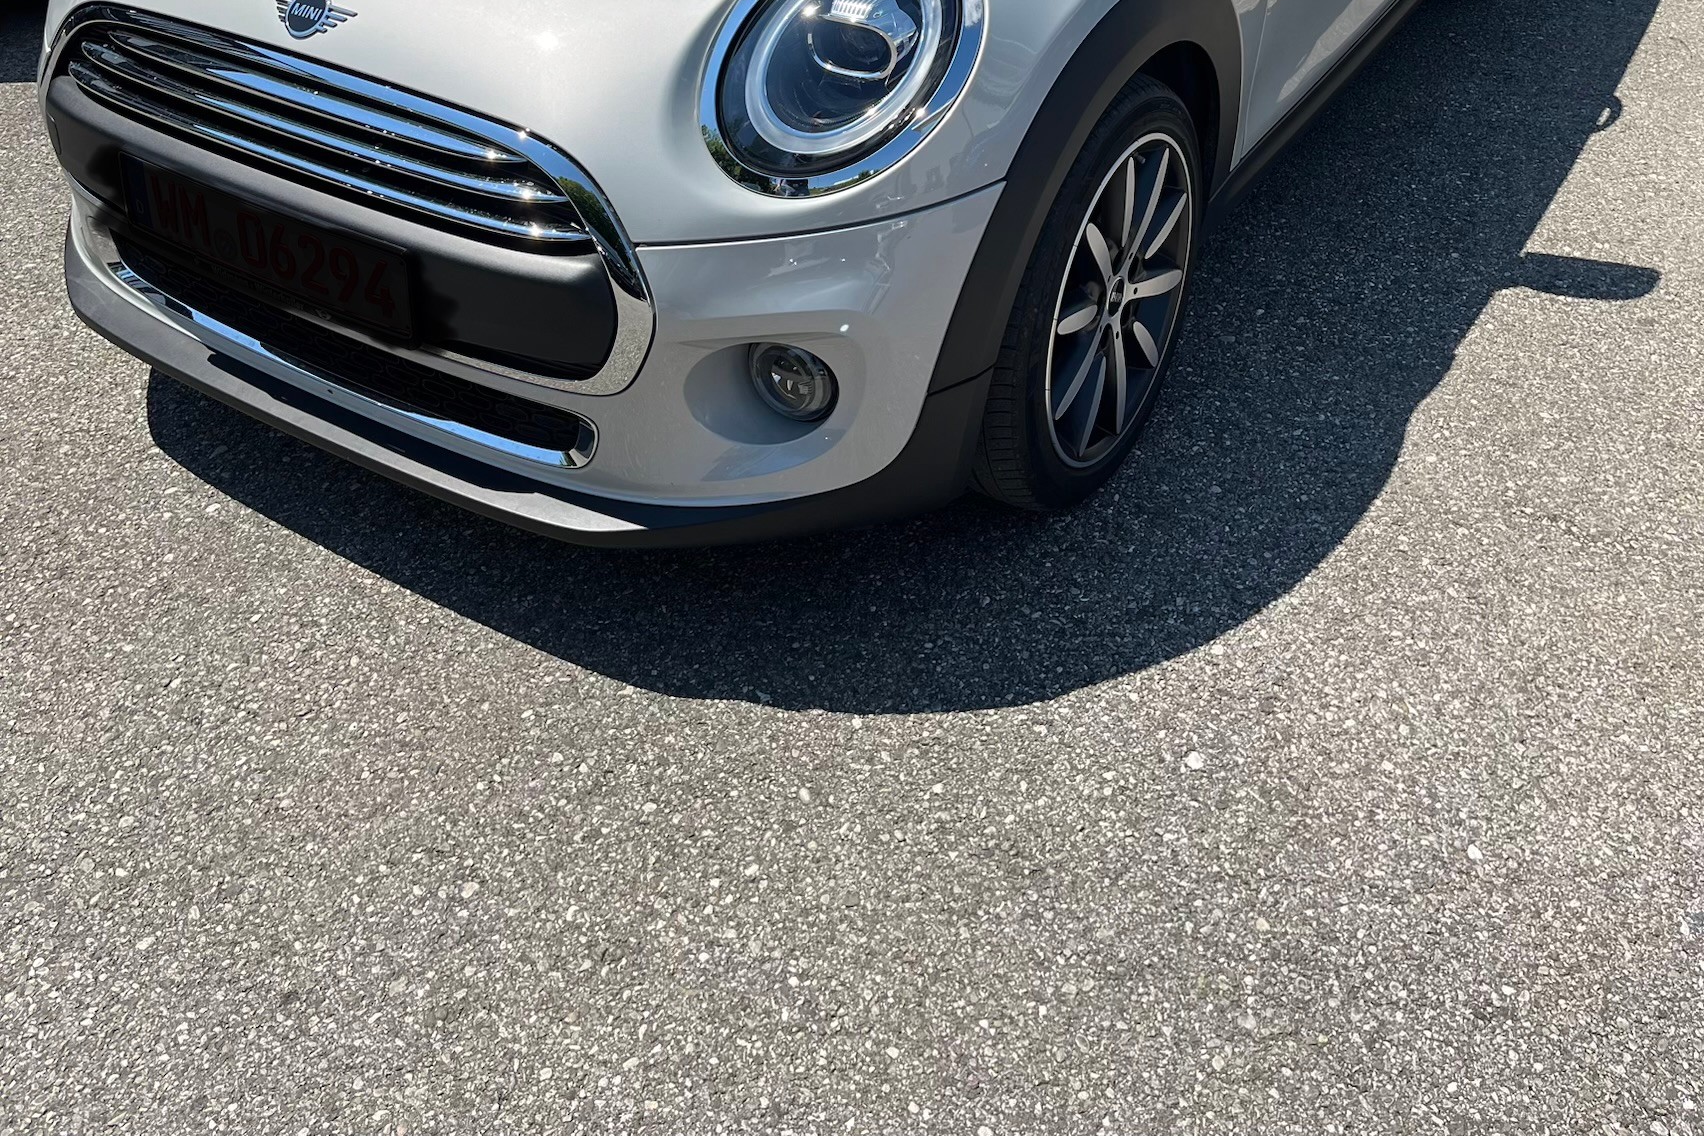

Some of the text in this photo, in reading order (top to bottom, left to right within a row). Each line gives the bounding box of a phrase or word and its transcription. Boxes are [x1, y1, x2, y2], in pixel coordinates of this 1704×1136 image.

[291, 2, 322, 21] MINI
[150, 174, 212, 249] WM
[235, 209, 397, 319] 06294
